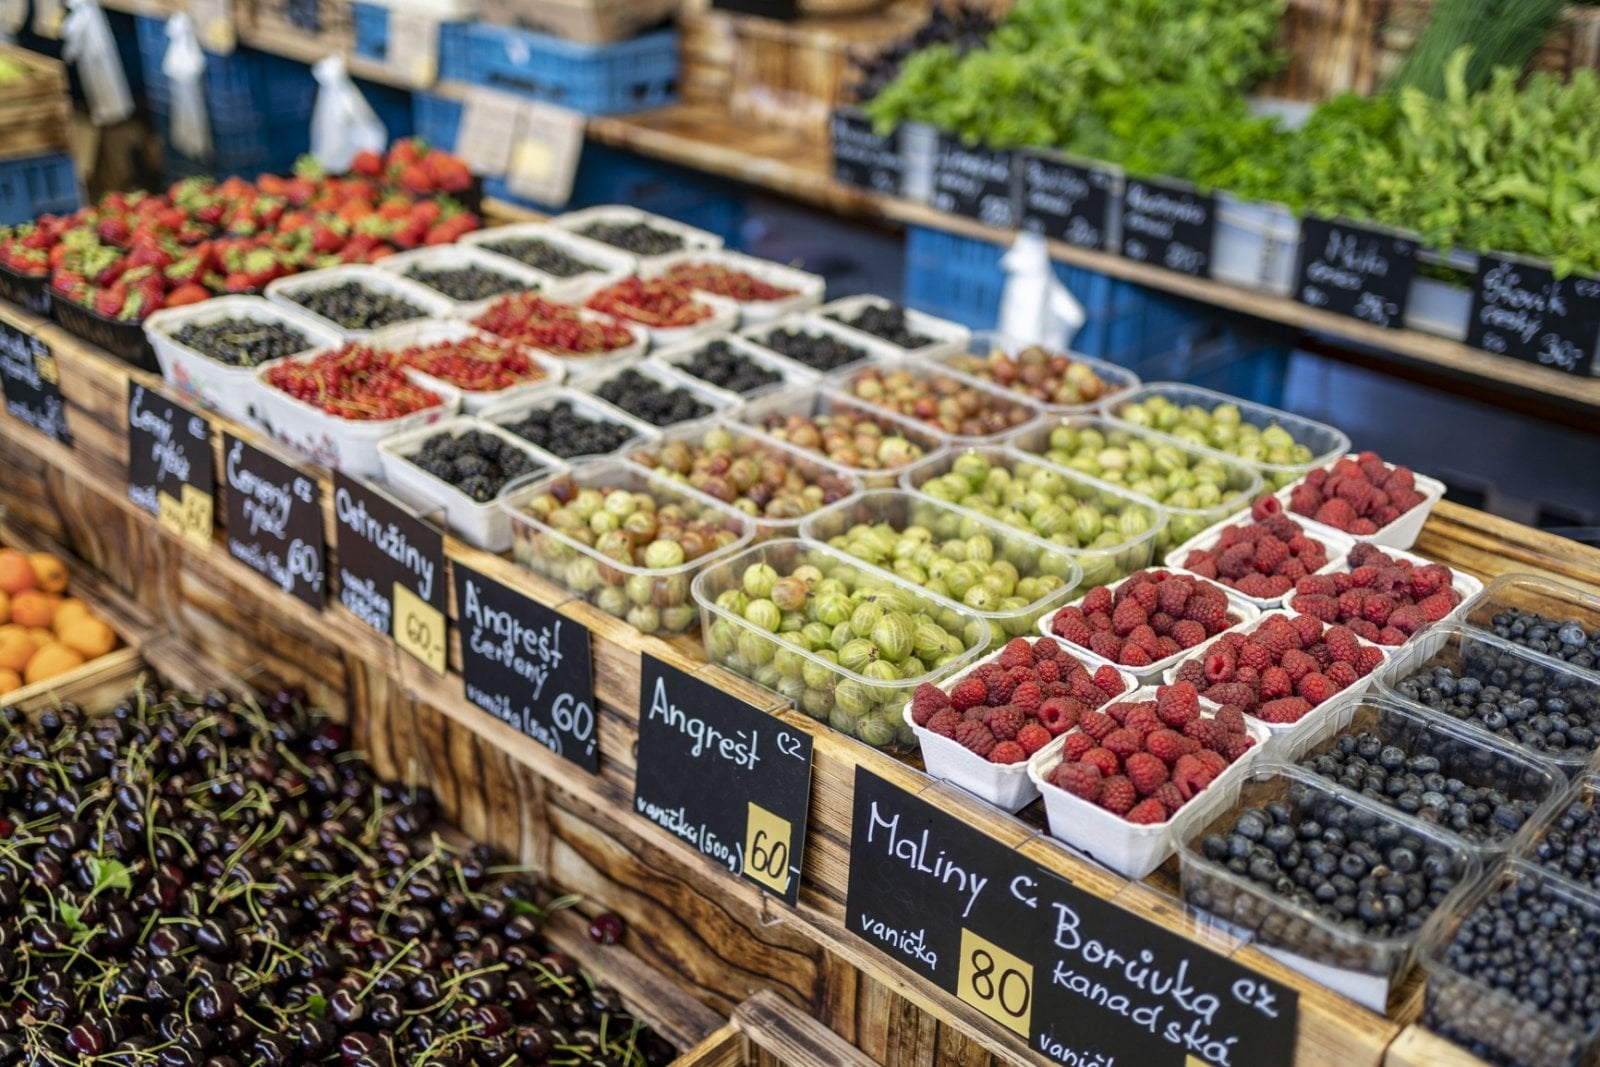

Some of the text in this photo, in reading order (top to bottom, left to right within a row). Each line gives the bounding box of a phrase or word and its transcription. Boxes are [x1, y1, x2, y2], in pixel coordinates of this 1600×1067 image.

[335, 486, 434, 601] Ostružiny
[406, 611, 443, 661] 60,-
[648, 675, 761, 771] Angrešt
[860, 913, 938, 971] vanička
[970, 948, 1031, 1018] 80
[1052, 901, 1221, 1026] Borůvka
